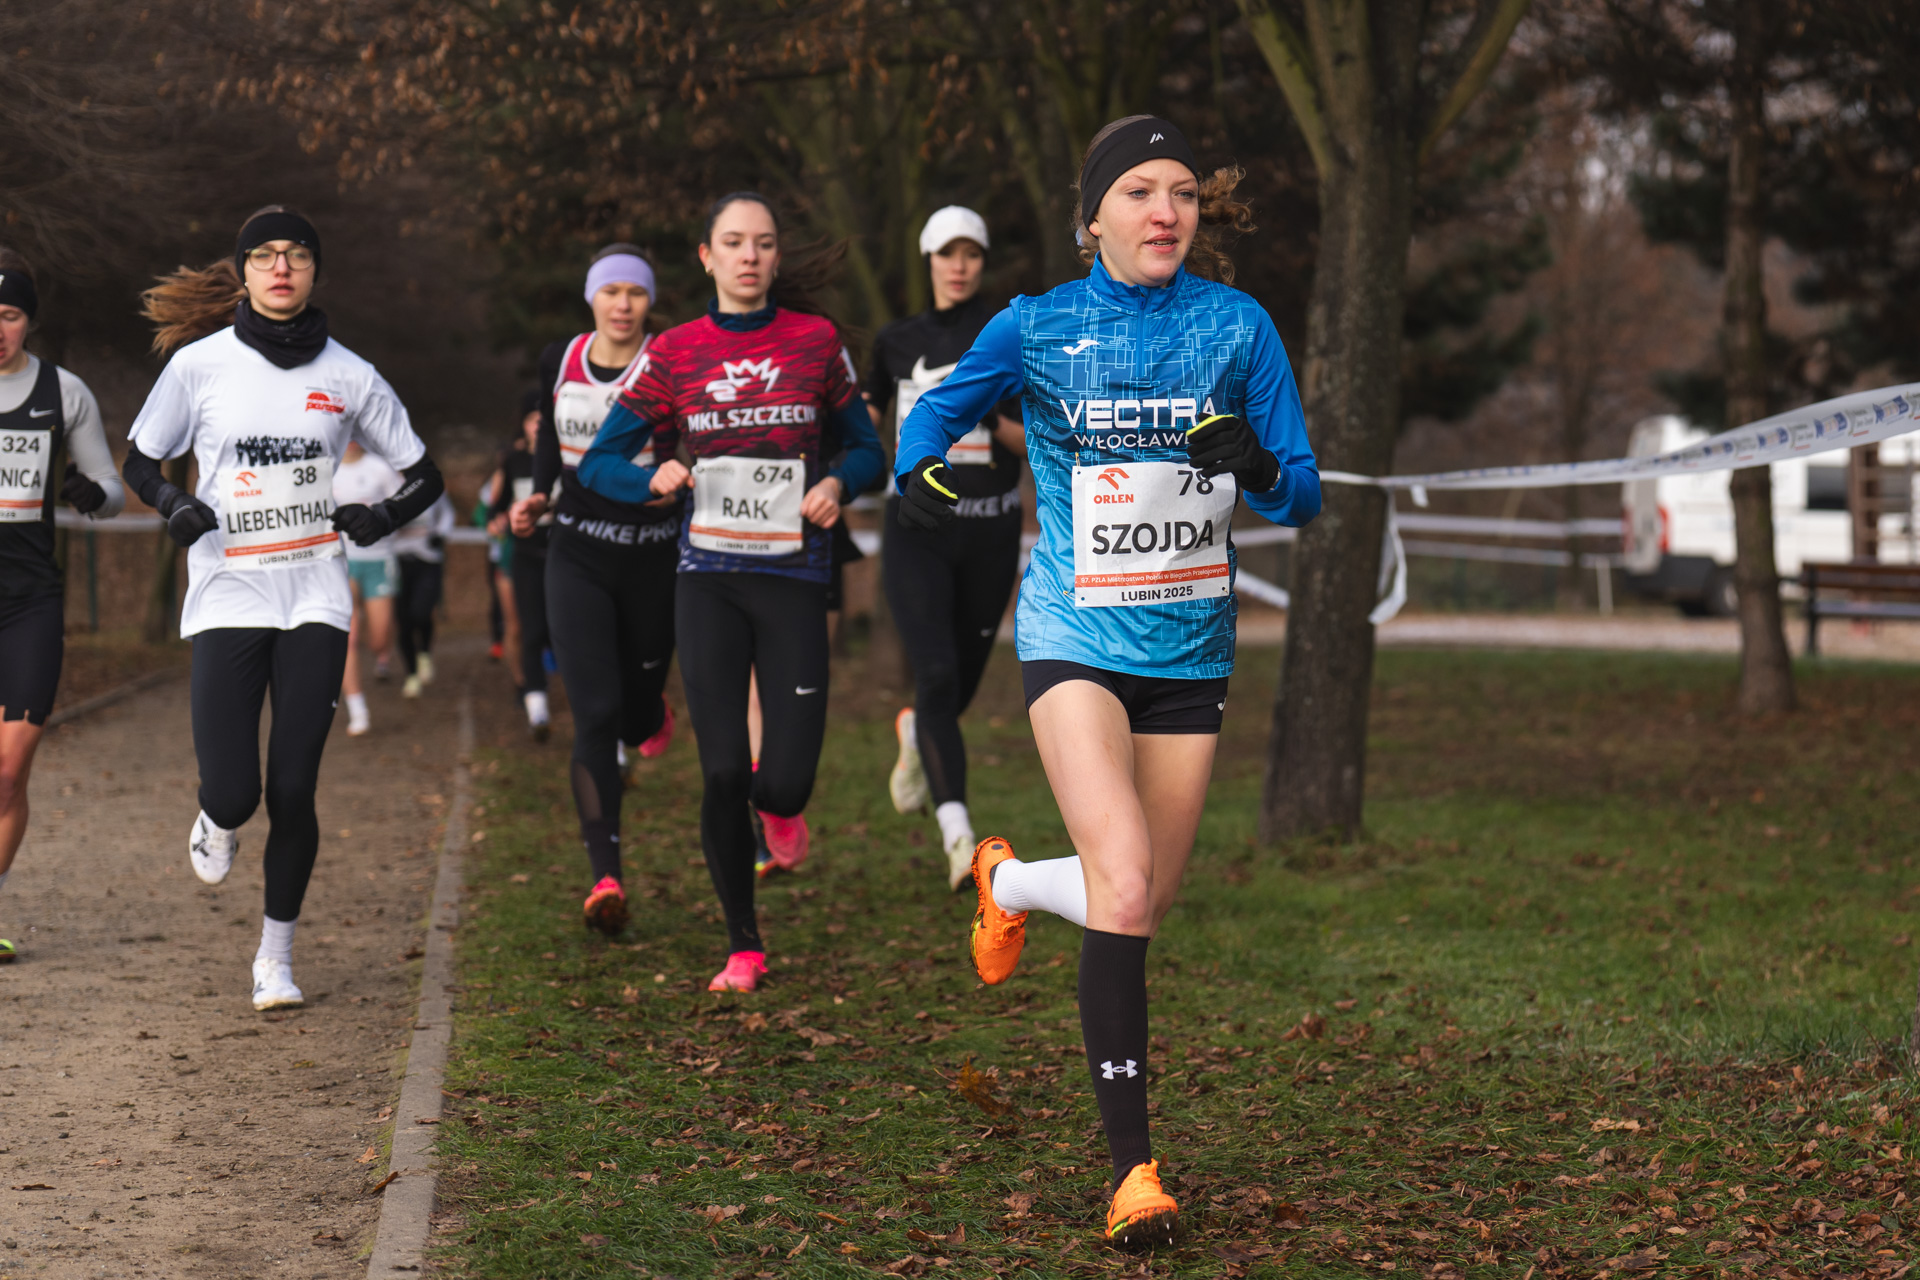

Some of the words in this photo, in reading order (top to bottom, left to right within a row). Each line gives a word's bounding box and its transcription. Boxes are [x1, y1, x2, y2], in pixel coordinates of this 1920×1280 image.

[687, 411, 724, 433] MKL
[1060, 396, 1216, 429] VECTRA
[557, 419, 599, 437] LEMA
[2, 436, 40, 453] 324
[0, 468, 41, 488] NICA
[293, 466, 317, 486] 38
[753, 465, 794, 483] 674
[1177, 469, 1214, 496] 78
[722, 496, 769, 520] RAK
[1093, 494, 1134, 505] ORLEN
[226, 500, 332, 534] LIEBENTHAL
[577, 519, 636, 544] NIKE
[637, 517, 677, 545] PRO
[1092, 520, 1213, 555] SZOJDA
[258, 555, 288, 565] LUBIN
[291, 549, 314, 560] 2025
[1145, 572, 1164, 580] Polski
[1170, 570, 1193, 580] Biegach
[1121, 589, 1161, 602] LUBIN
[1163, 585, 1194, 599] 2025
